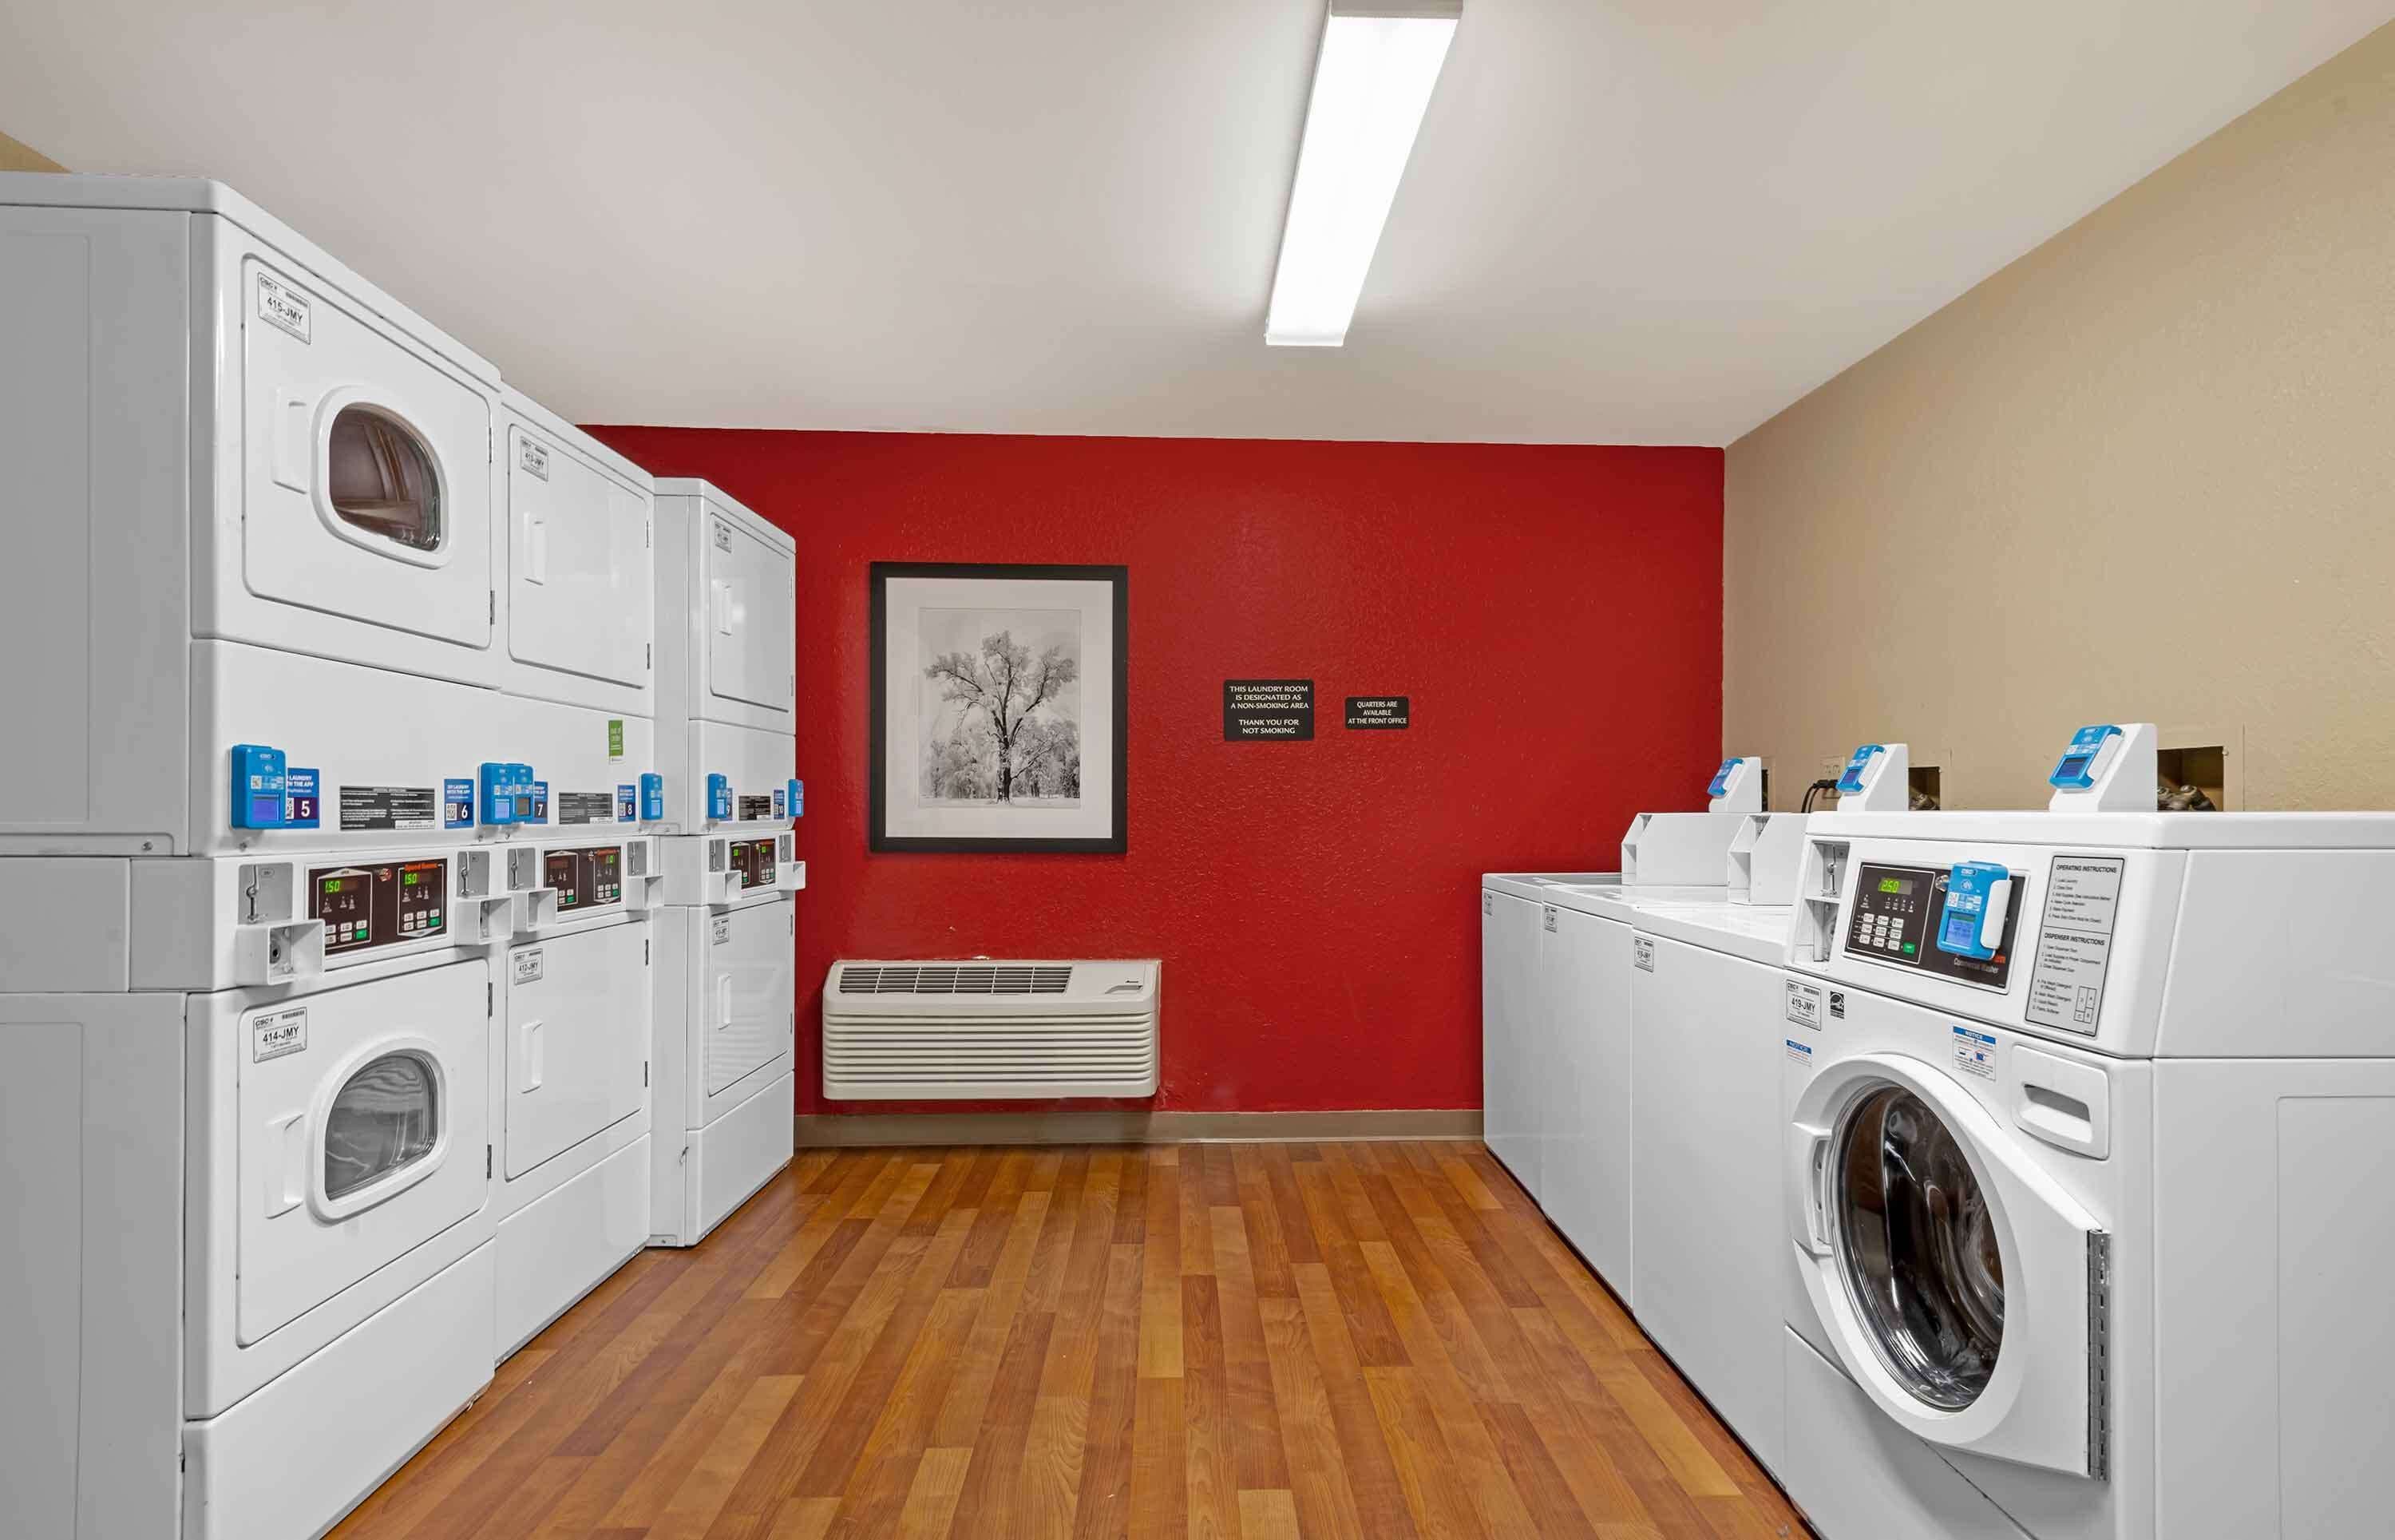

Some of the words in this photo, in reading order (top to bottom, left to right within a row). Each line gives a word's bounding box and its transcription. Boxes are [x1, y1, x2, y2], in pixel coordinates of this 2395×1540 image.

[267, 296, 303, 323] 415-JMY
[301, 800, 311, 818] 5
[461, 804, 468, 818] 6
[537, 804, 543, 816] 7
[627, 805, 632, 815] 8
[263, 1025, 299, 1043] 414-JMY
